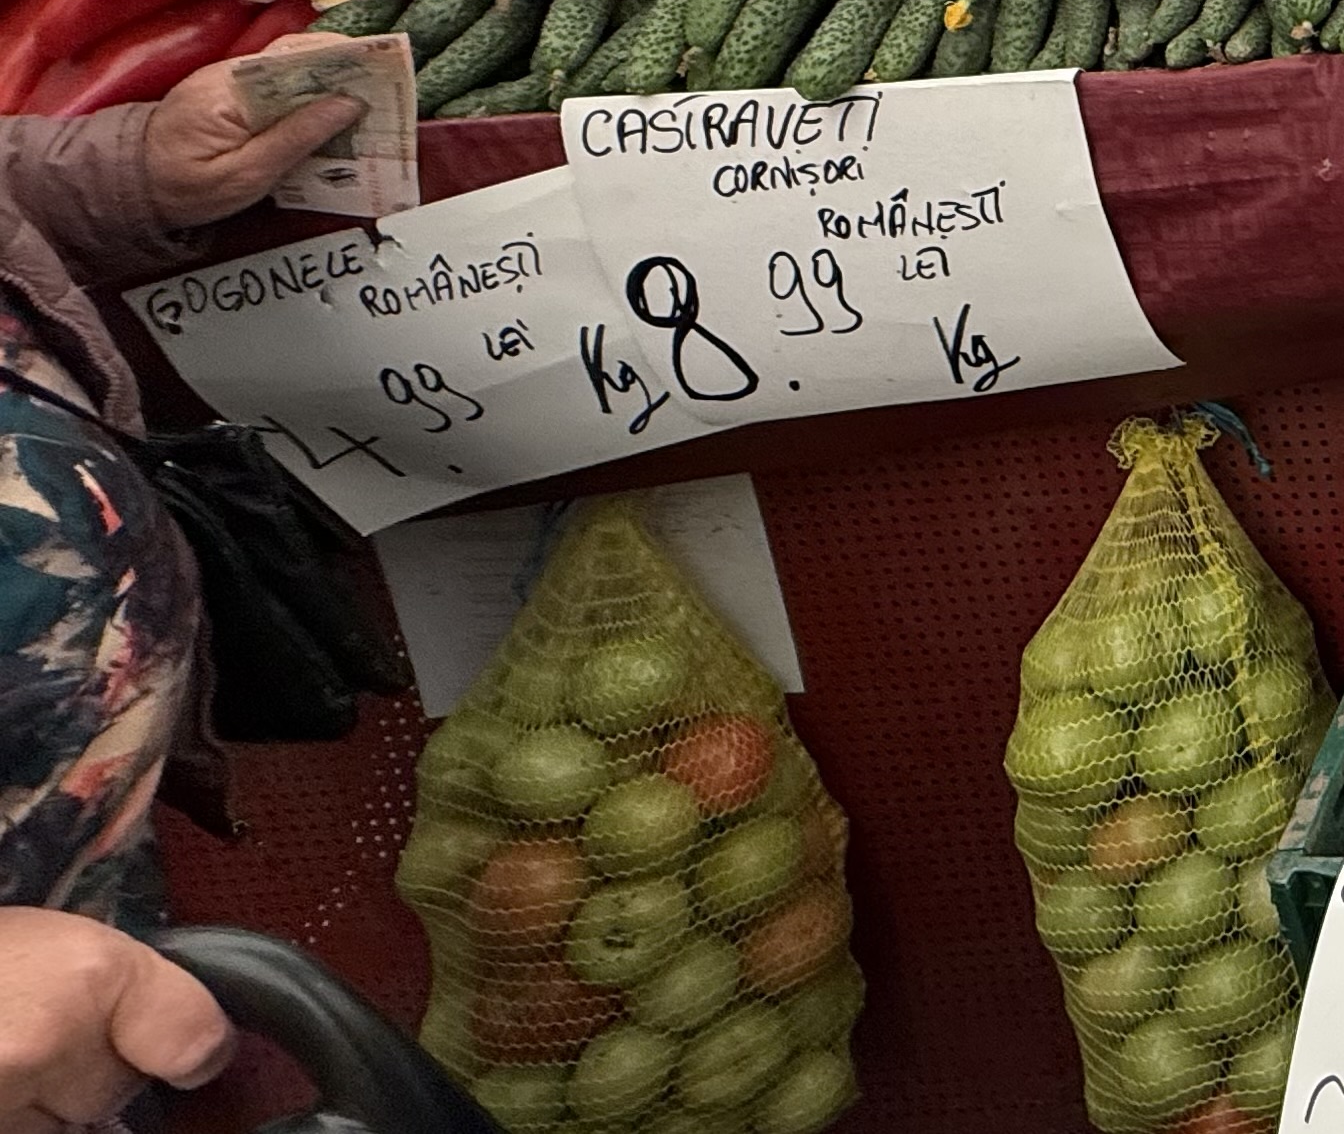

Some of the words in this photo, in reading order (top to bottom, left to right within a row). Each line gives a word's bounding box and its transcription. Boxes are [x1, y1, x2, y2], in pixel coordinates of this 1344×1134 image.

[482, 319, 535, 361] LEI
[580, 323, 669, 433] Kg
[898, 246, 951, 280] LEI
[933, 303, 1021, 393] Kg
